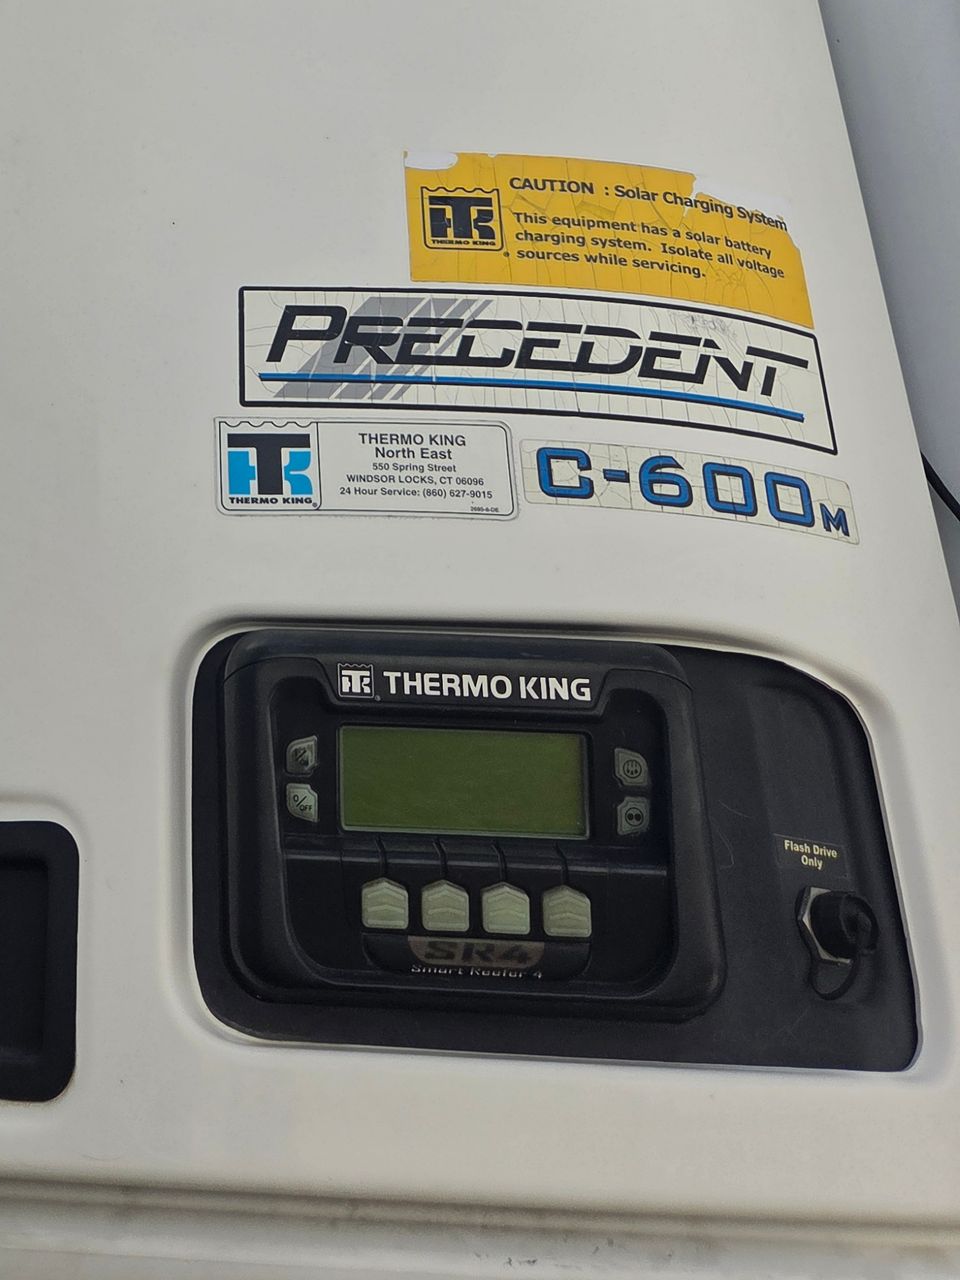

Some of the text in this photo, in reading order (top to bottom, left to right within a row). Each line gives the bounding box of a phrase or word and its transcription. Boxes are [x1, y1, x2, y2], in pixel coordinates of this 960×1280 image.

[509, 177, 594, 194] CAUTION
[615, 185, 658, 201] Solar
[663, 191, 733, 218] Charging
[737, 206, 787, 231] System
[513, 212, 772, 259] This equipment has a solar battery
[515, 230, 785, 278] charging system. Isolate all voltage
[517, 249, 706, 278] sources while servicing.
[266, 304, 809, 397] PRECEDENT
[359, 433, 466, 446] THERMO KING
[375, 447, 452, 459] North East
[392, 463, 424, 473] Spring
[427, 464, 456, 472] Street
[346, 474, 484, 486] WINDSOR LOCKS, CT 06096
[340, 487, 493, 499] 24 Hour Service: (860) 627-9015
[383, 671, 512, 699] THERMO
[520, 676, 592, 701] KING
[784, 839, 838, 858] Flash Drive
[801, 854, 823, 870] Only
[424, 940, 531, 964] SR4
